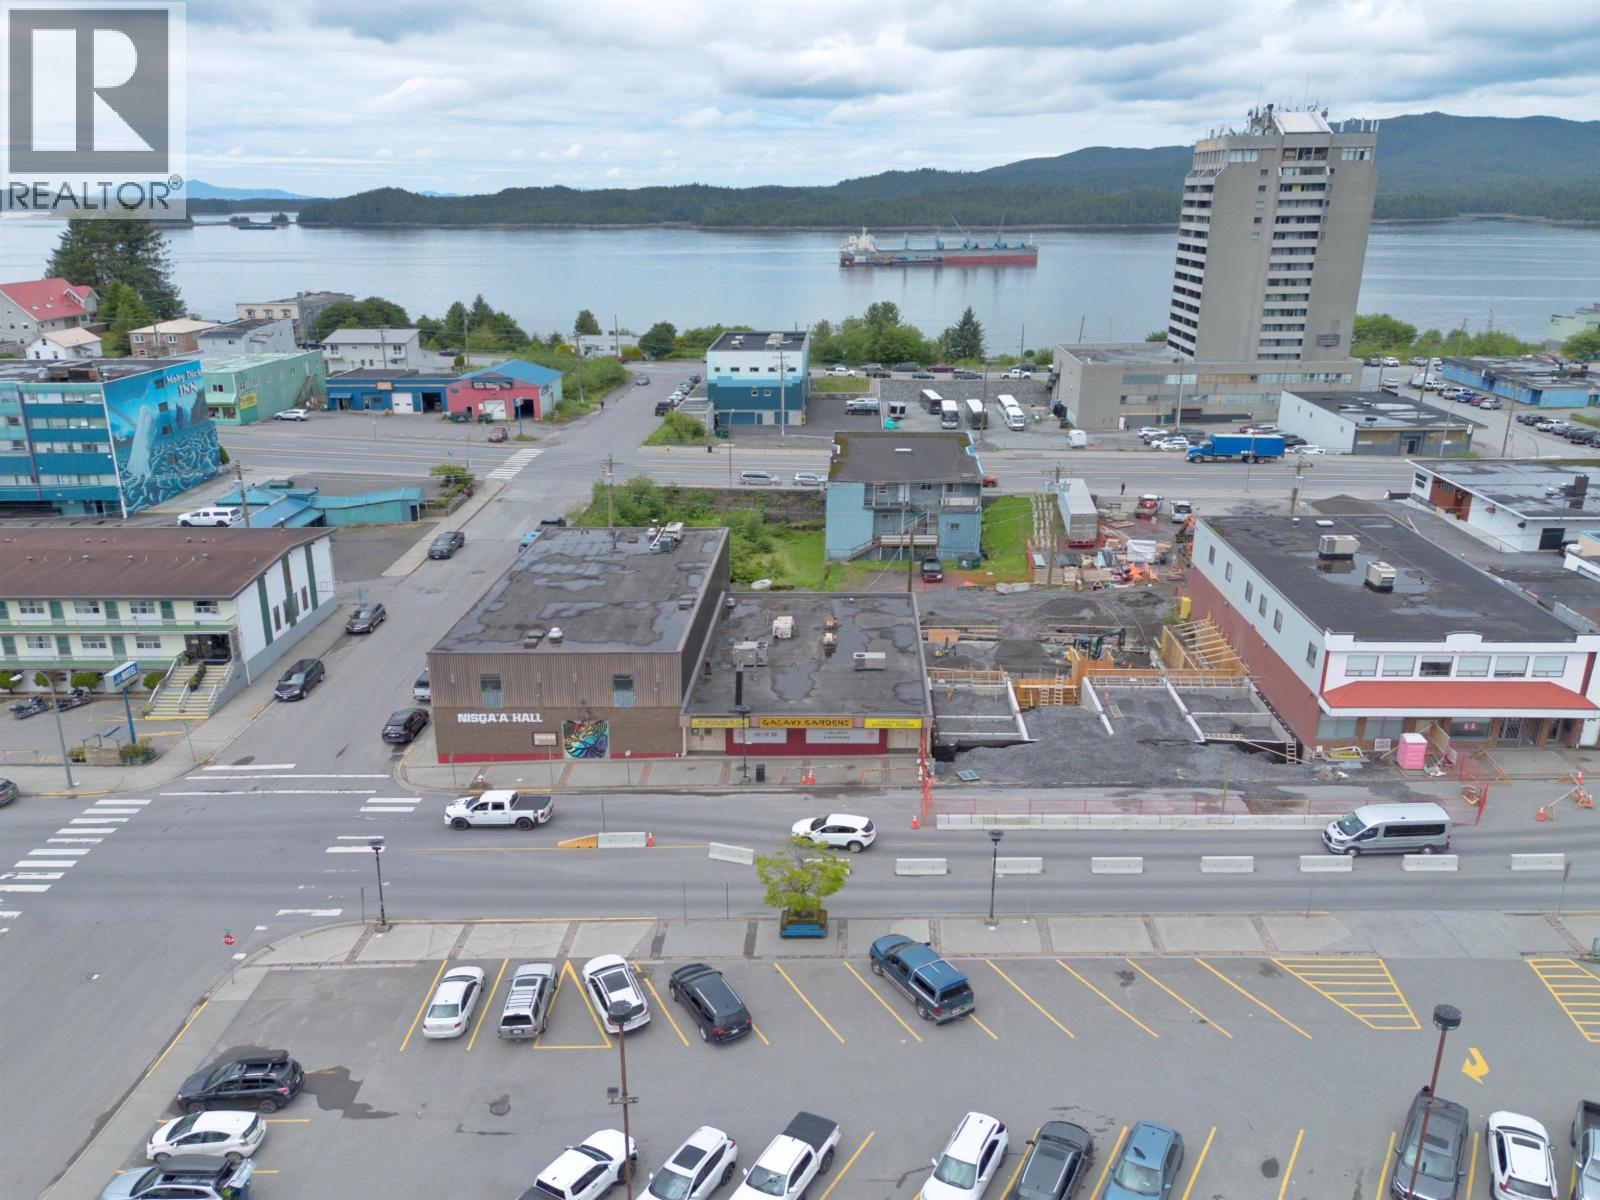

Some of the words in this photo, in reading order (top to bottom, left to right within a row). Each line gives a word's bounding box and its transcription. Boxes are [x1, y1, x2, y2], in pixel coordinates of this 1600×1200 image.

[179, 382, 197, 395] INN
[457, 713, 509, 724] NISGA'A
[512, 713, 544, 723] HALL
[762, 719, 801, 728] GALAXY
[804, 719, 849, 728] GARDENS
